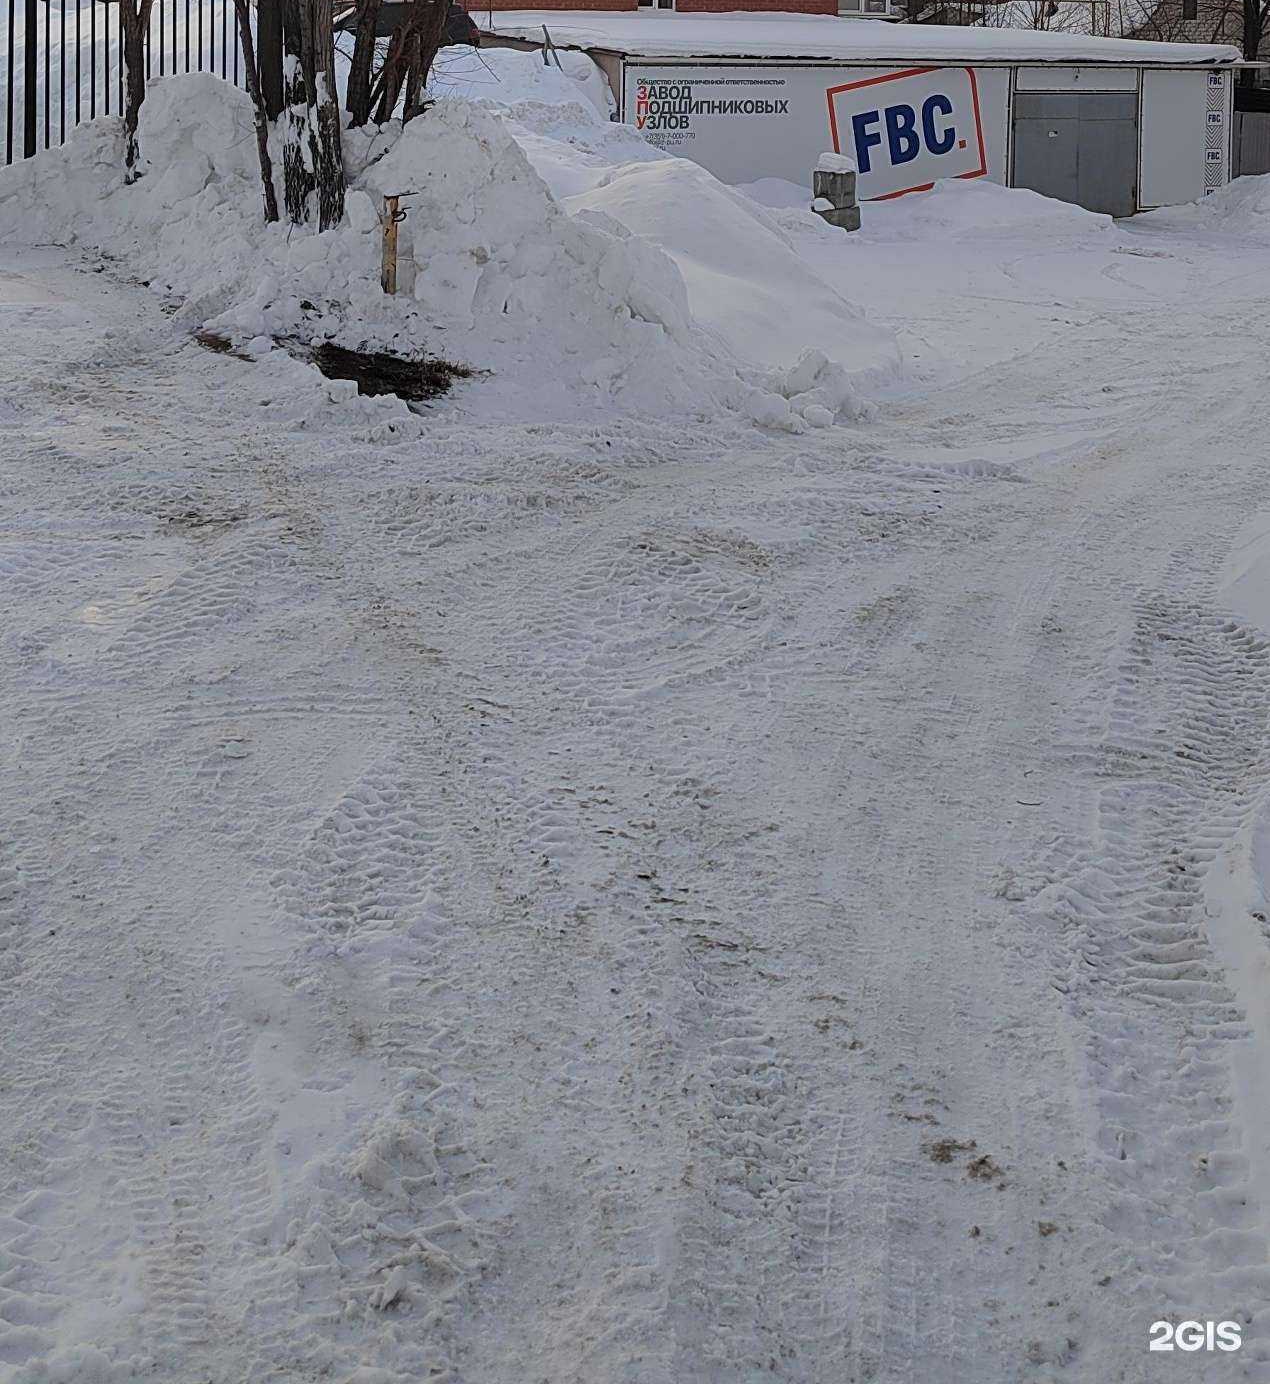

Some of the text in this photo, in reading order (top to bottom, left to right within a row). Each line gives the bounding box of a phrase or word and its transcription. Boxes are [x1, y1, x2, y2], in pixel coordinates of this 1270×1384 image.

[1209, 77, 1222, 85] FBC
[636, 85, 692, 101] ЗАВОД
[636, 99, 789, 116] ПОДШИПНИКОВЫХ
[636, 115, 690, 130] УЗЛОВ
[1208, 114, 1221, 123] FBC
[1207, 151, 1220, 160] FBC
